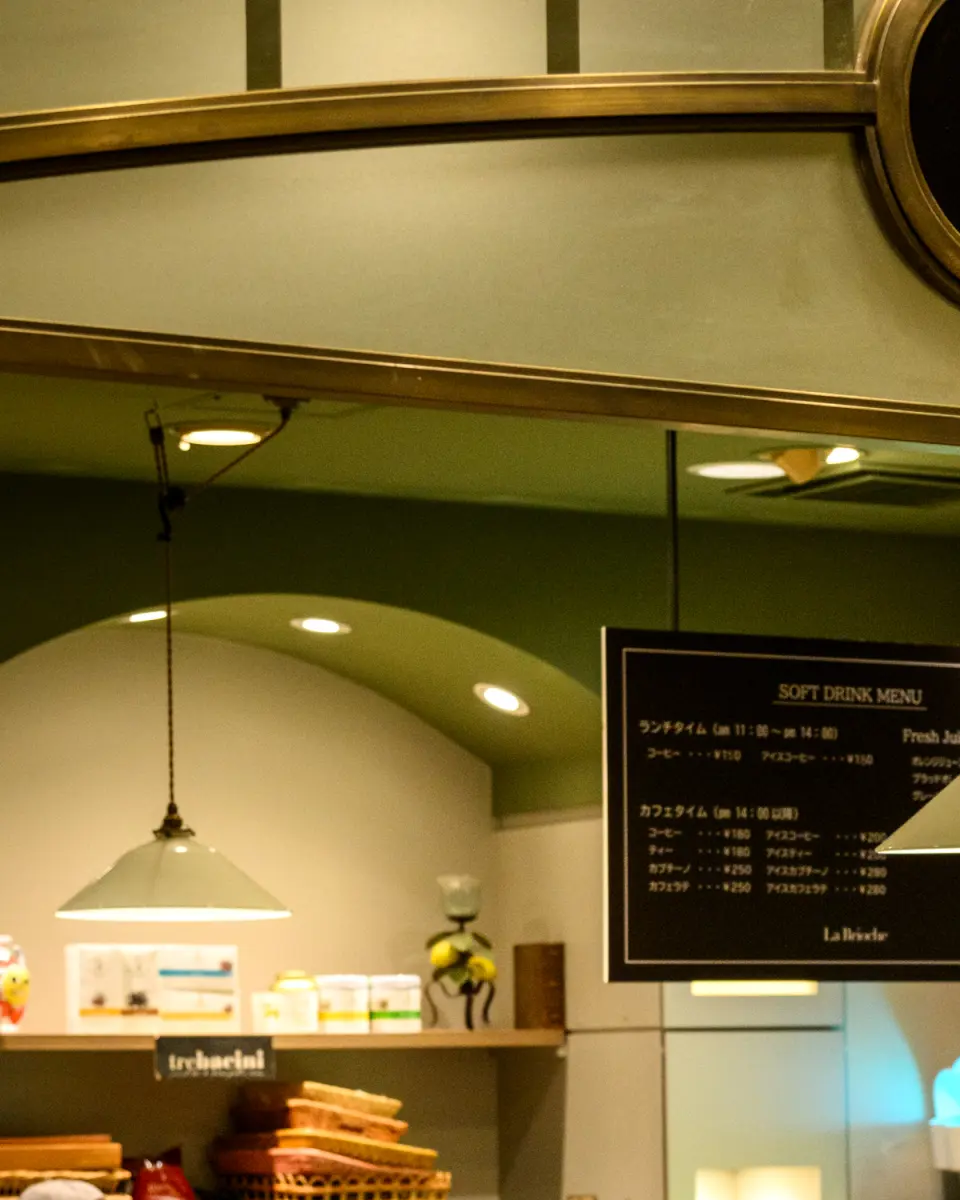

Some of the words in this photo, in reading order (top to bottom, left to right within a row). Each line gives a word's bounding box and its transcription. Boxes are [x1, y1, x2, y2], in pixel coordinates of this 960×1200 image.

[778, 683, 820, 701] SOFT
[823, 684, 873, 703] DRINK
[876, 686, 923, 706] MENU
[902, 728, 940, 744] Fresh
